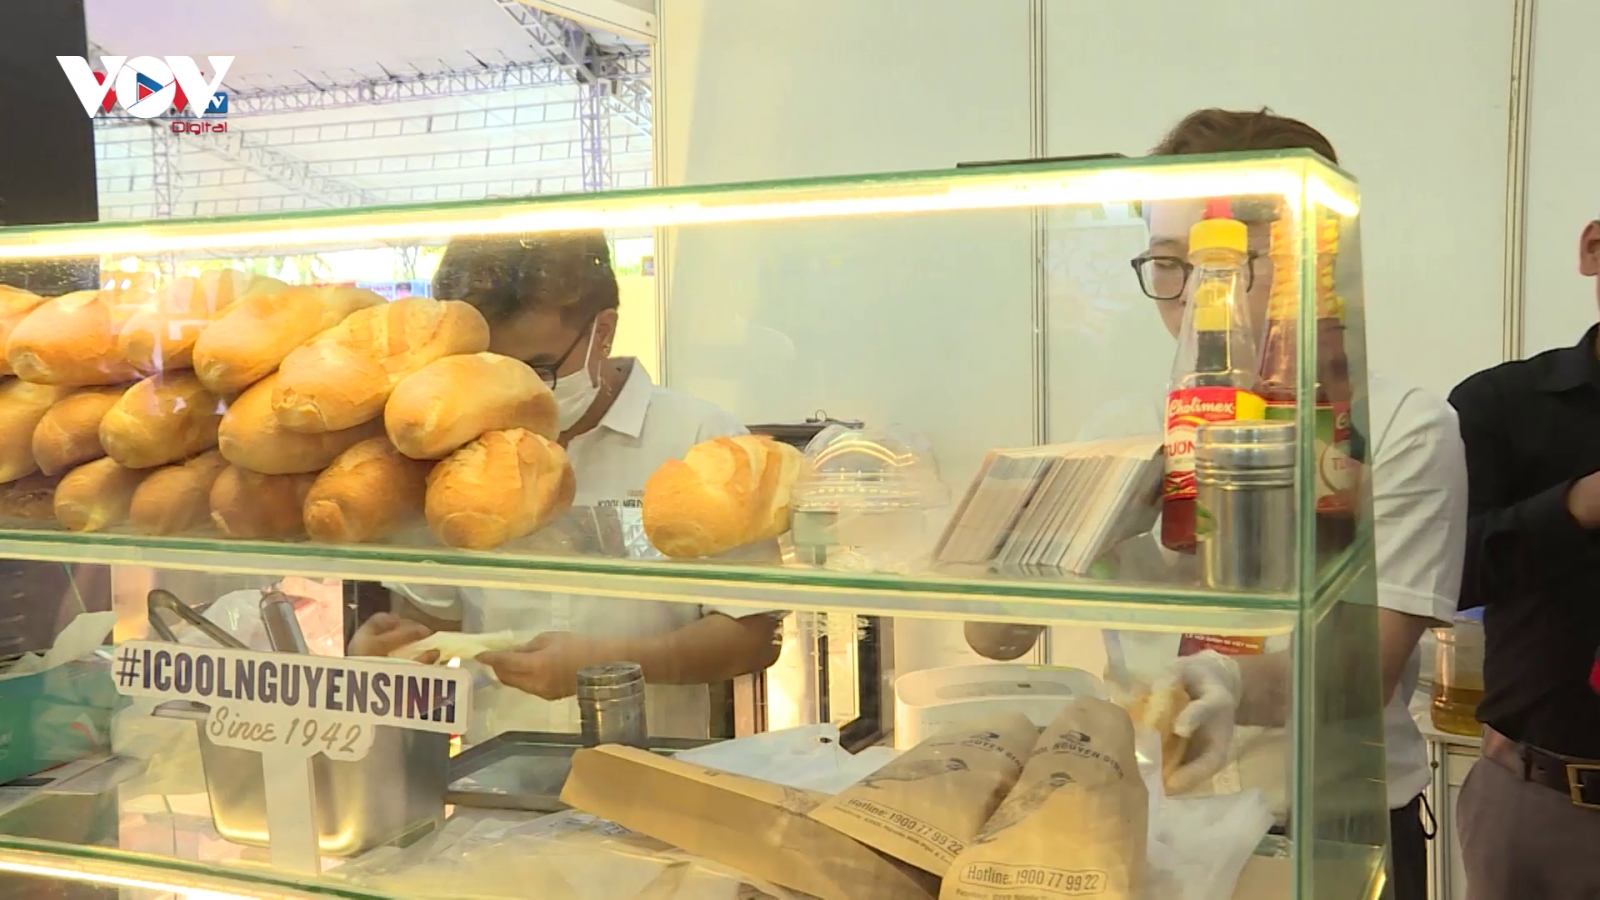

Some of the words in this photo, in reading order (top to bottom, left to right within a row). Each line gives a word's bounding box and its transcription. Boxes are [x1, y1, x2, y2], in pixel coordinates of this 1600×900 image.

[1169, 396, 1235, 416] Cholimex
[115, 647, 457, 723] #ICOOLNGUYENSINH
[210, 705, 277, 743] Since
[284, 717, 361, 753] 1942
[889, 813, 917, 831] 1900
[917, 824, 932, 836] 77
[931, 831, 949, 846] 99
[947, 840, 964, 856] 22
[1016, 869, 1045, 885] 1900
[1047, 872, 1064, 888] 77
[1065, 874, 1083, 891] 99
[1083, 873, 1100, 891] 22
